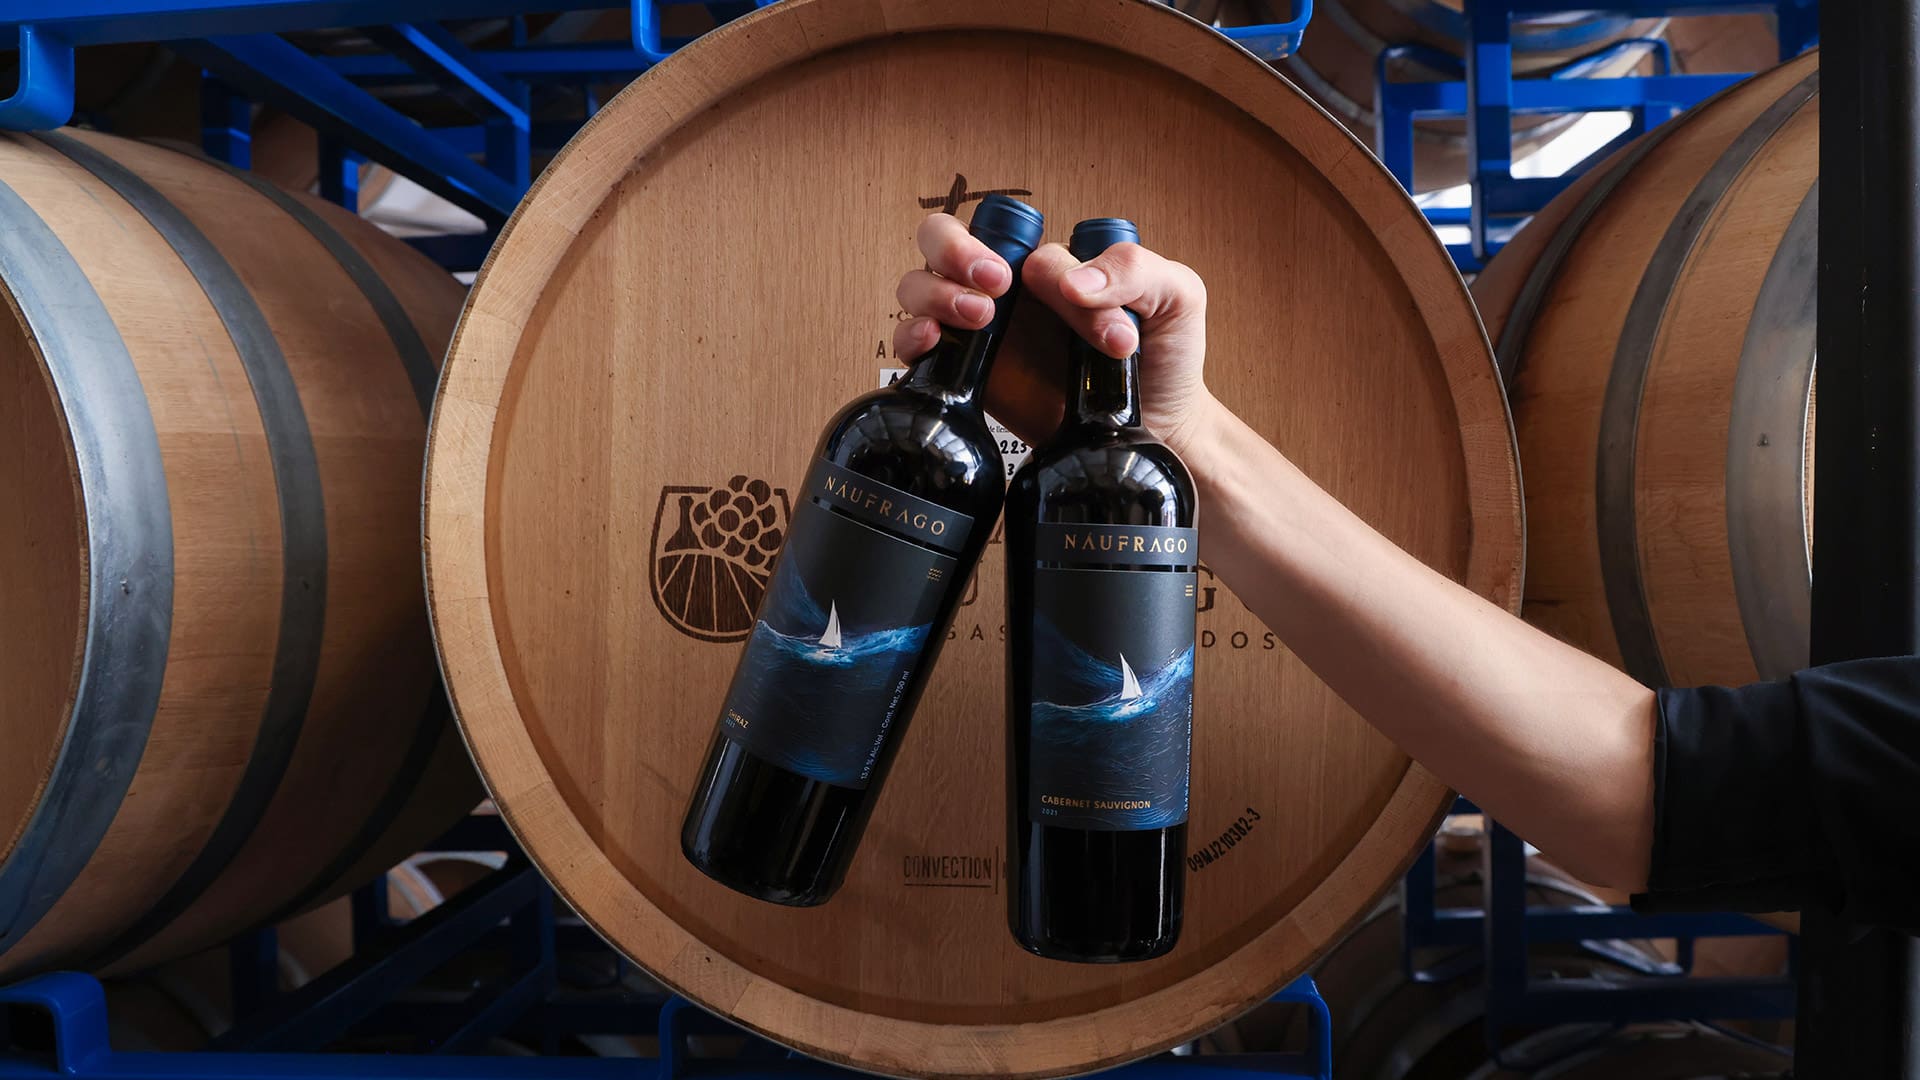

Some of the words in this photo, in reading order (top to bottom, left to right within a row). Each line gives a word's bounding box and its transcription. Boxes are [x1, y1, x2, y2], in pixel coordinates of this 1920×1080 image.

[824, 475, 946, 536] NÁUFRAGO
[1064, 531, 1188, 554] NÁUFRAGO
[1041, 794, 1091, 809] CABERNET
[1094, 800, 1152, 811] SAUVIGNON
[903, 855, 993, 880] CONVECTION
